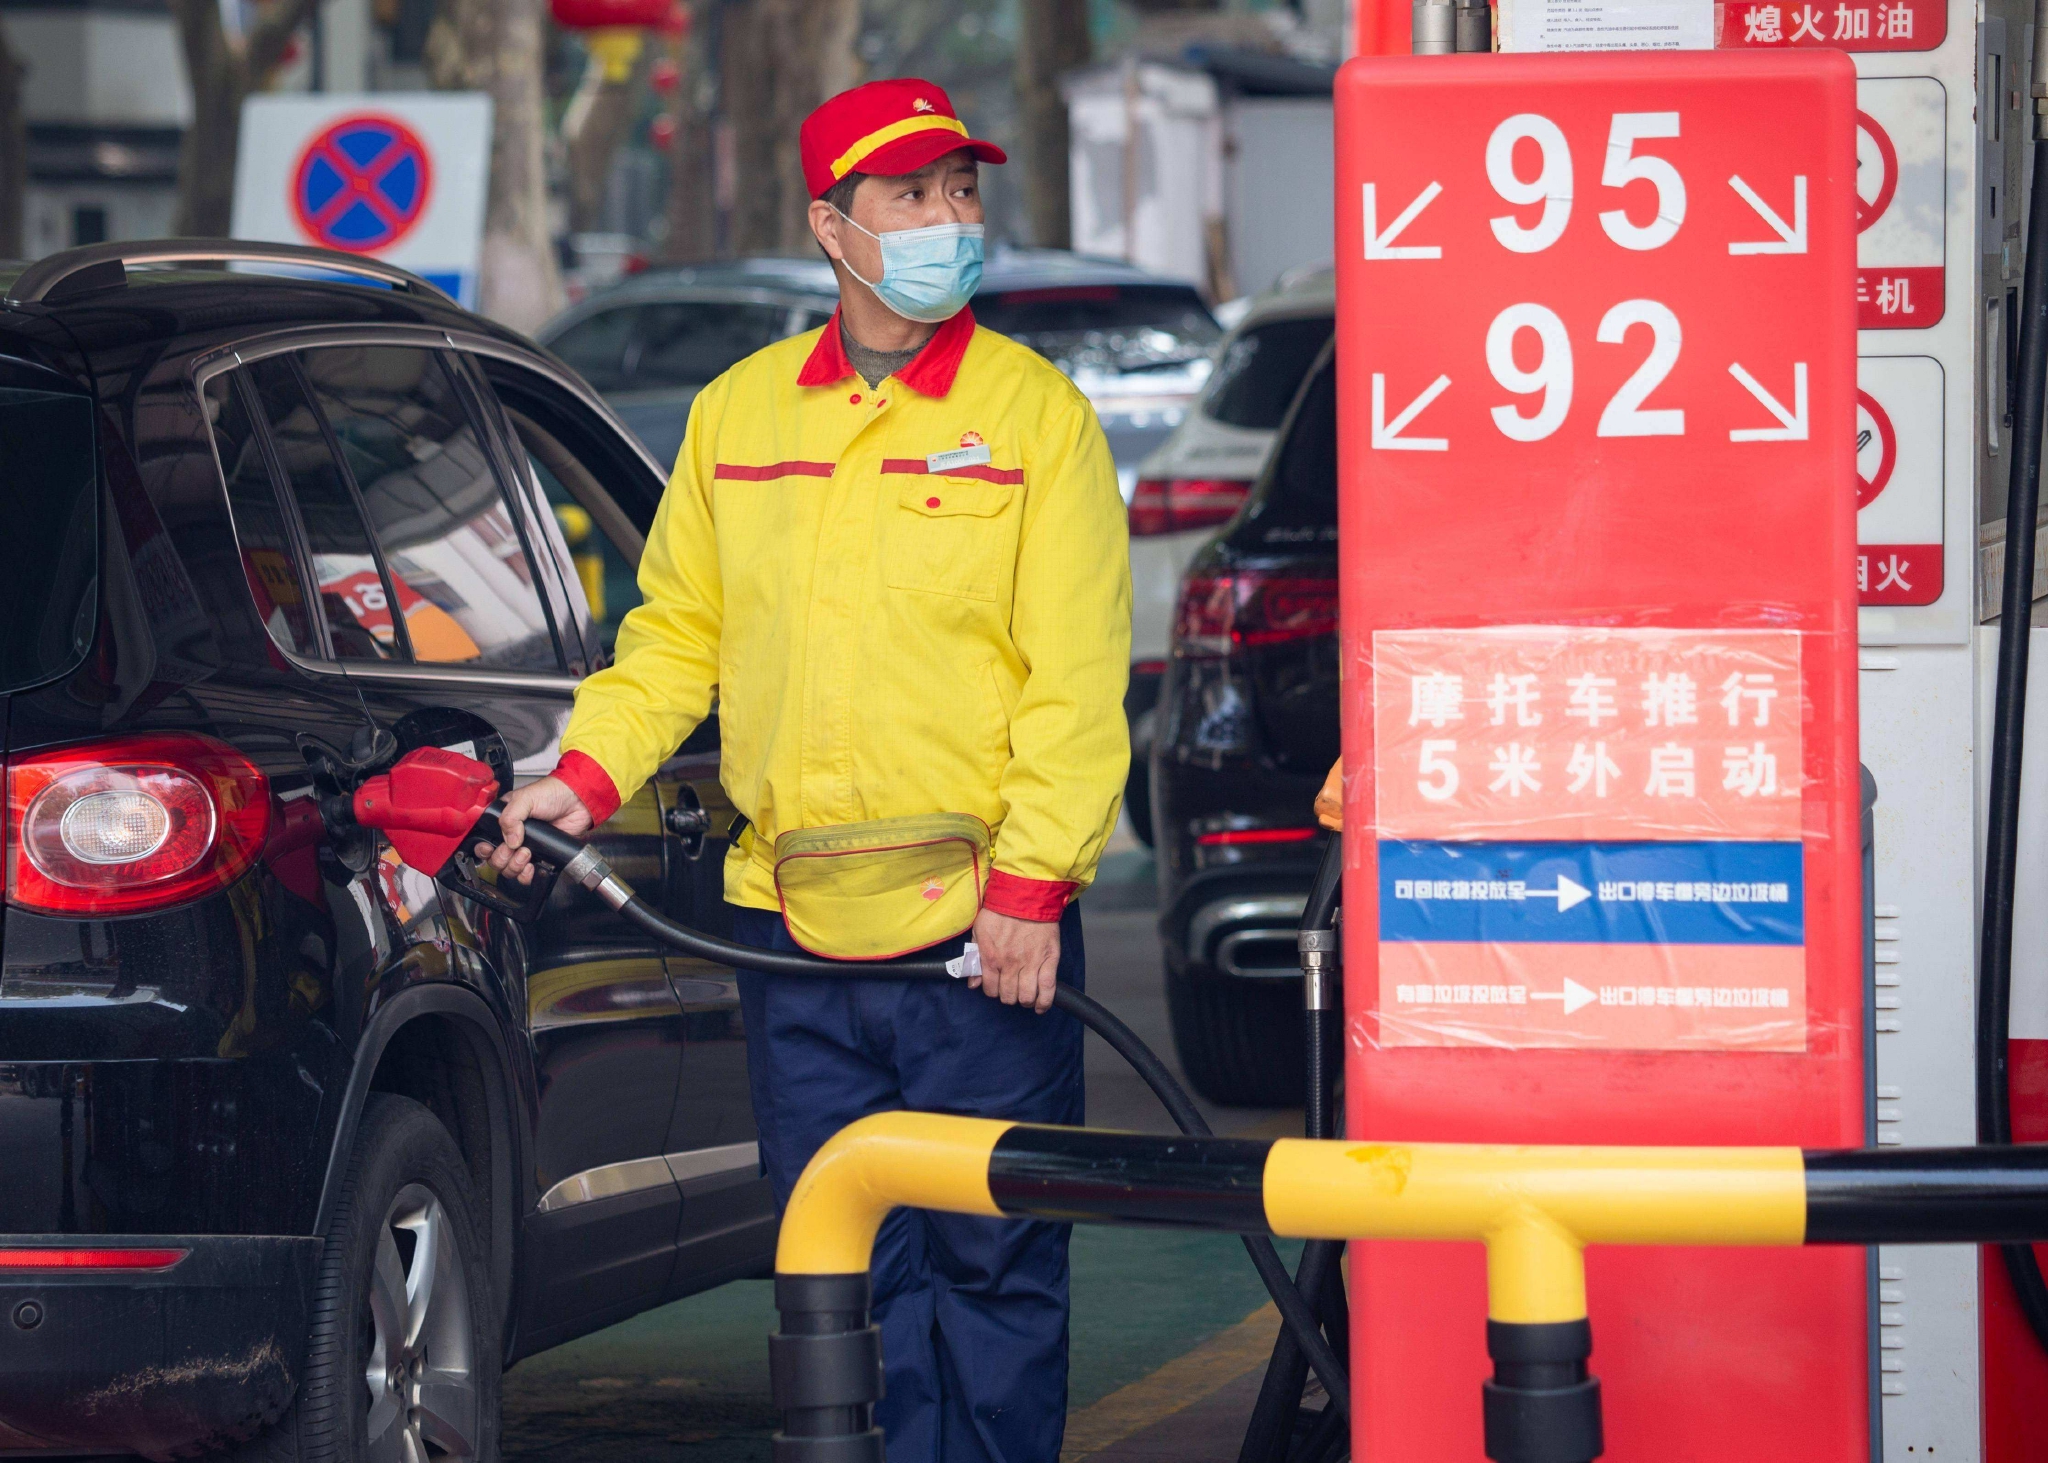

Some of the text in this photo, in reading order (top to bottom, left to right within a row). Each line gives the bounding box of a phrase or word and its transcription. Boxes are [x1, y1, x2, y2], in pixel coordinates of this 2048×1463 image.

[1743, 1, 1914, 44] 熄火加油
[1485, 111, 1687, 254] 95
[1485, 298, 1686, 442] 92
[1407, 671, 1779, 728] 摩托车推行
[1416, 739, 1778, 800] 5米外启动
[1394, 879, 1527, 901] 可回收物投放至
[1396, 984, 1527, 1005] 有害垃圾投放至
